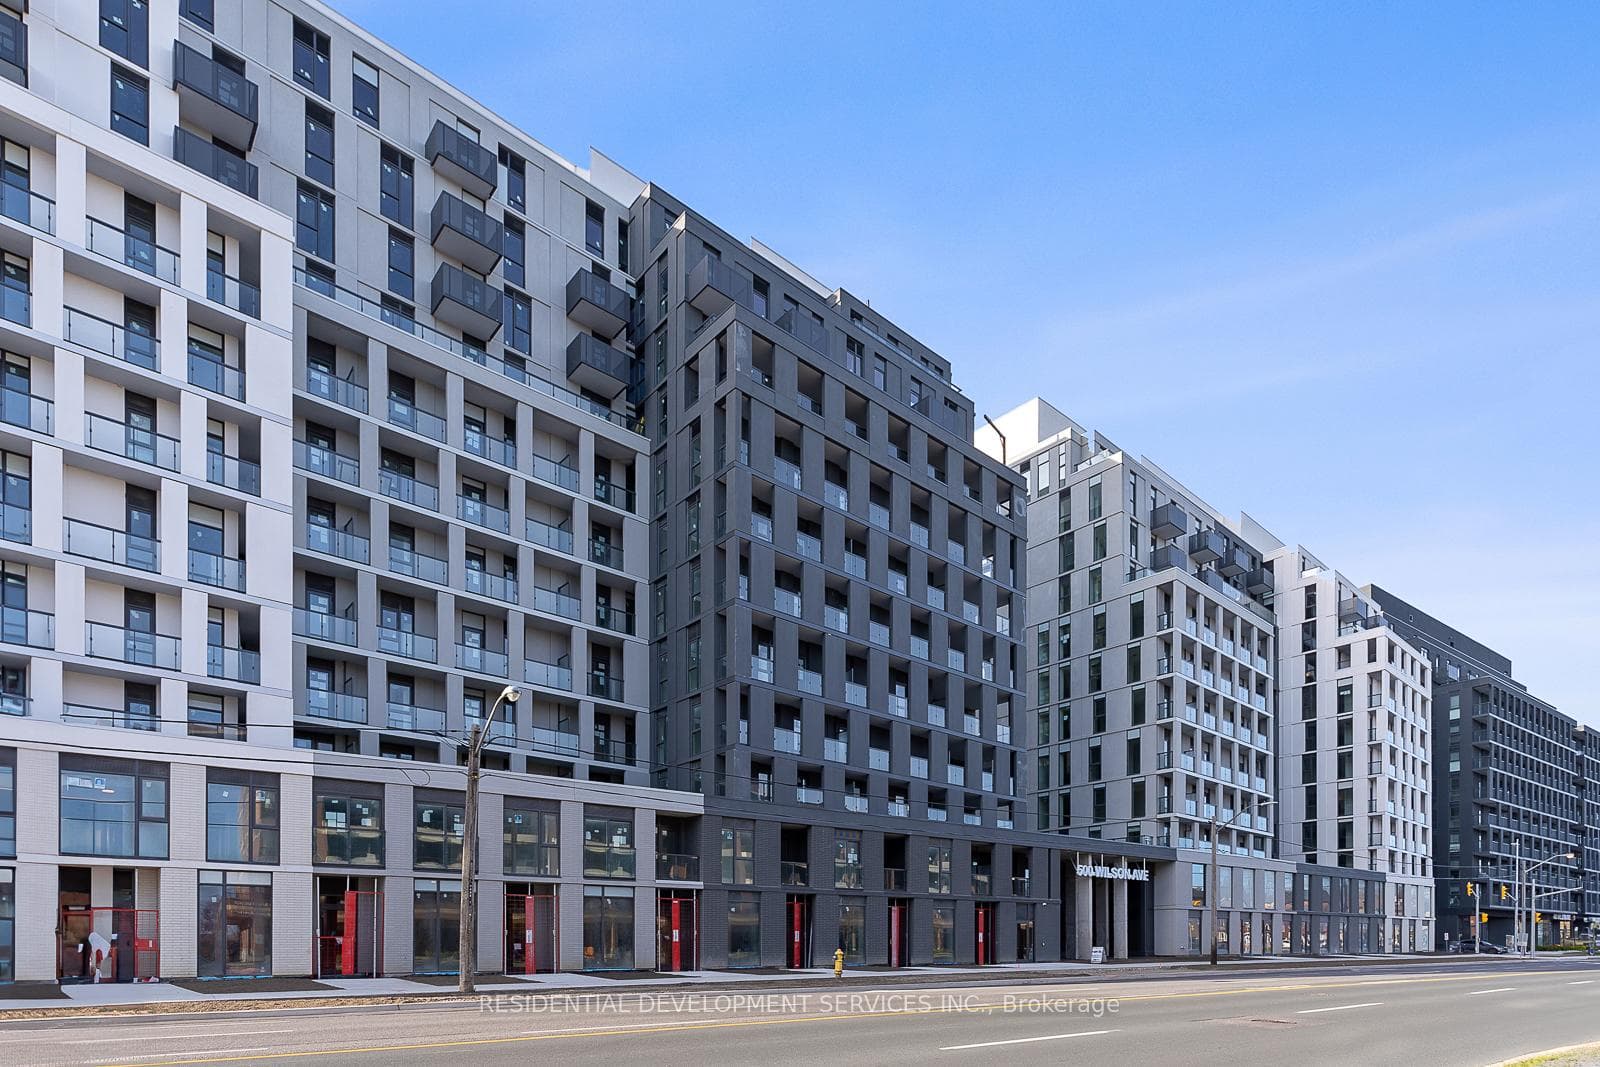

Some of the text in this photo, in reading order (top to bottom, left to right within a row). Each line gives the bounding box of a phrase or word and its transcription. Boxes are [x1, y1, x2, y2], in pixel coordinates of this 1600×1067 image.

[1076, 865, 1149, 881] 500 WILSON AVE
